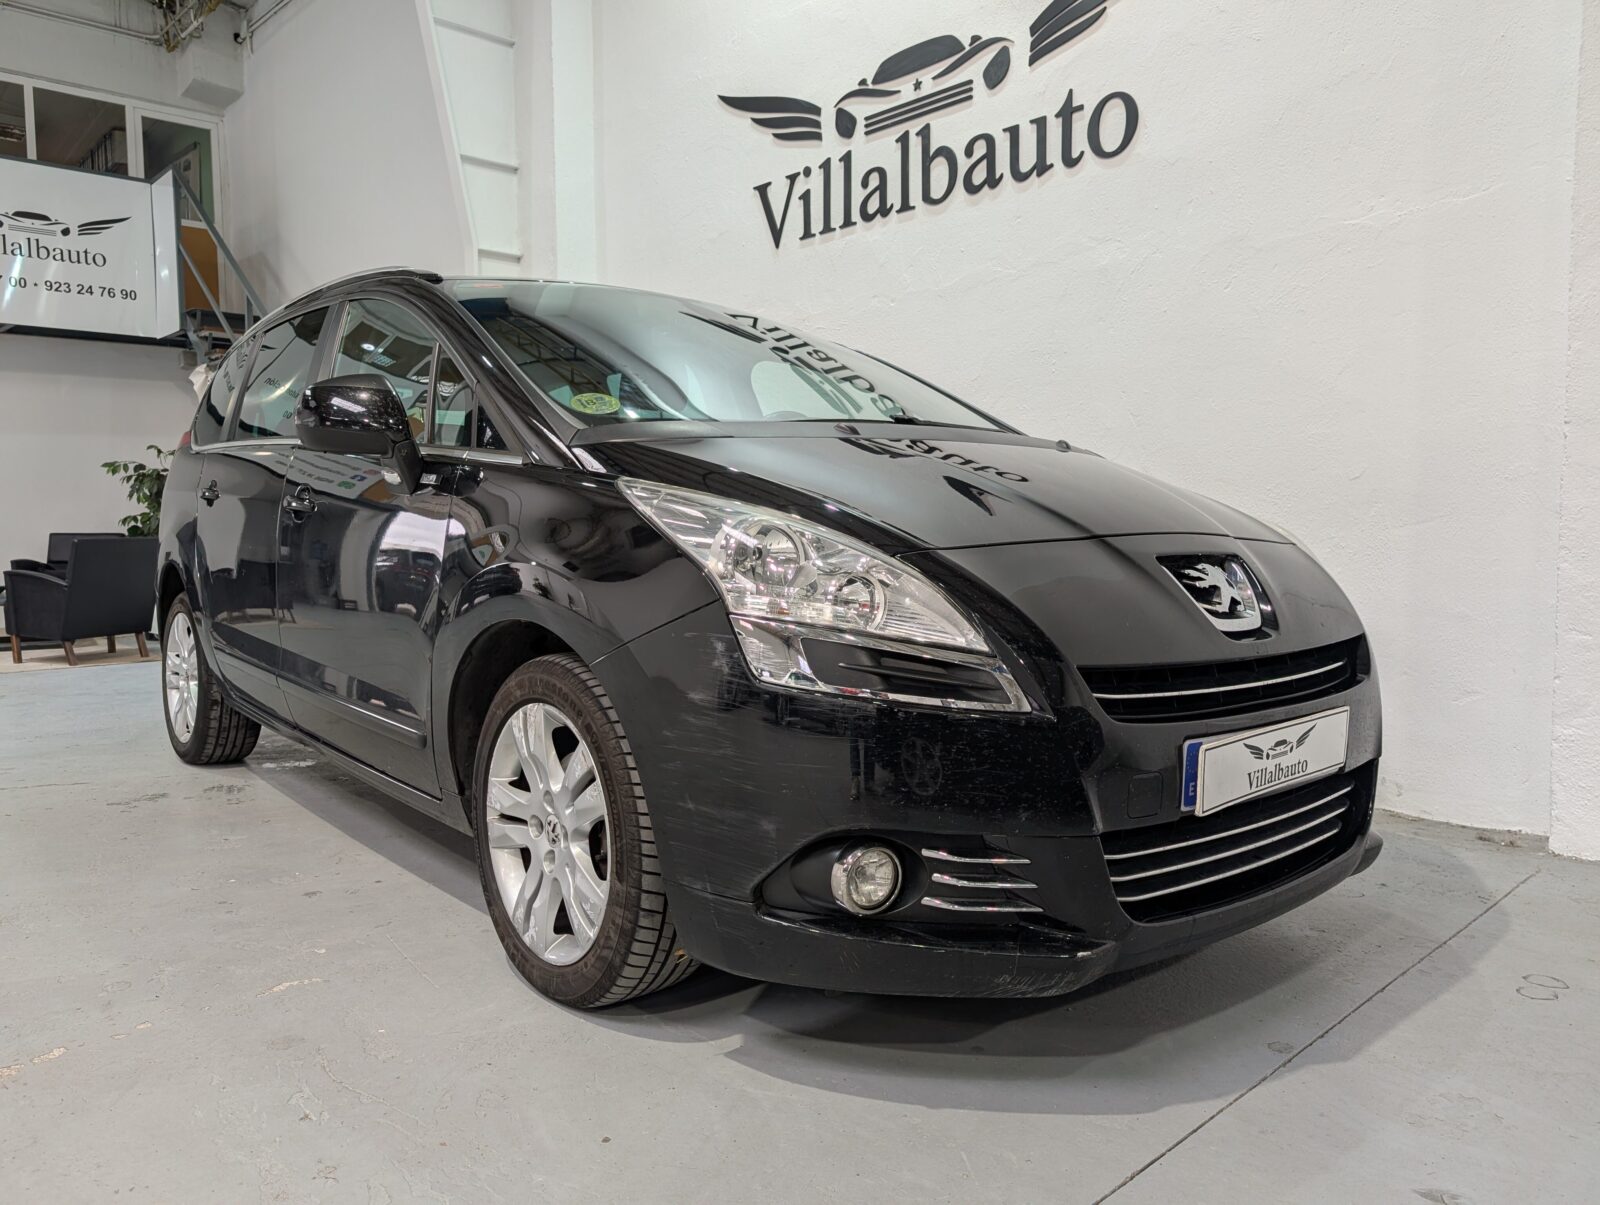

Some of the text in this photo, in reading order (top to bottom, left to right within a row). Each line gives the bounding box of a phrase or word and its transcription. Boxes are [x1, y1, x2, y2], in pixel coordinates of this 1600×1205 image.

[753, 88, 1139, 249] Villalbauto
[44, 280, 72, 294] 923
[76, 283, 94, 296] 24
[99, 286, 116, 299] 76
[120, 288, 137, 301] 90
[1247, 758, 1308, 791] Villalbauto
[1188, 781, 1196, 796] E
